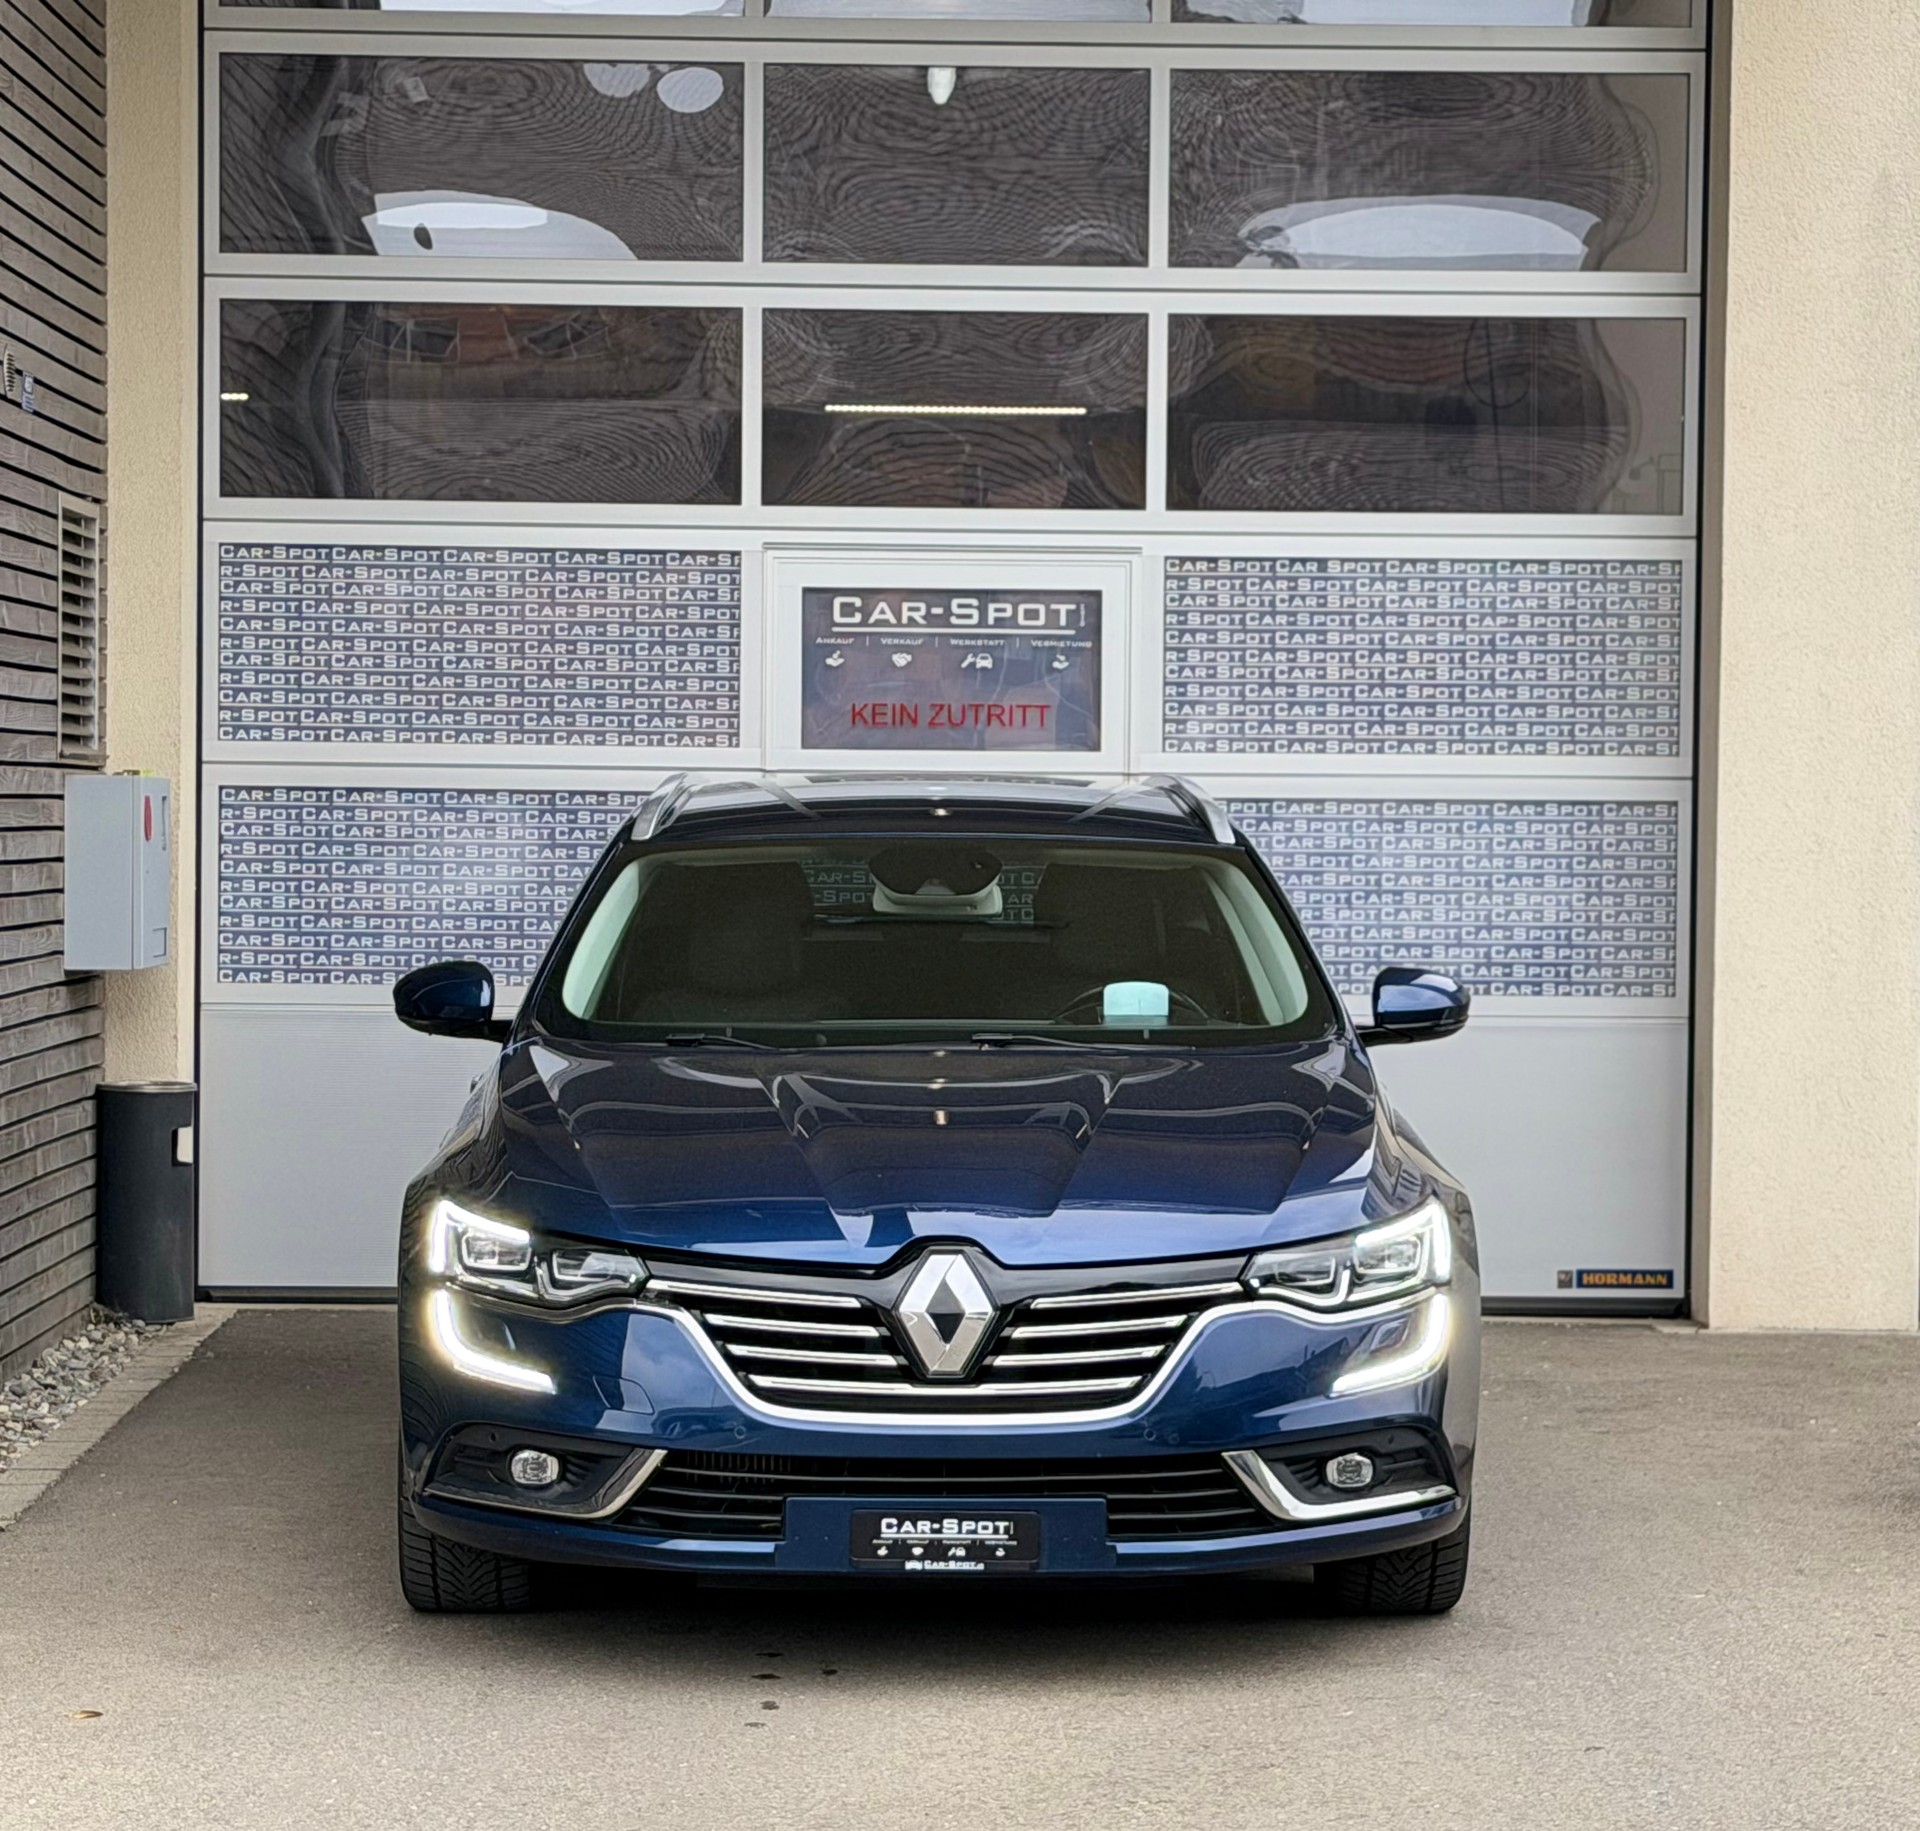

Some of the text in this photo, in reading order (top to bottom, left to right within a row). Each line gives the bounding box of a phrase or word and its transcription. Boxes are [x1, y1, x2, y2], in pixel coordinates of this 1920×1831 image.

[220, 545, 664, 565] CAR-SPOT CAR-SPOT CAR-SPOT CAR-SPOT
[302, 565, 411, 580] CAR-SPOT
[413, 567, 523, 581] CAR-SPOT
[525, 568, 634, 583] CAR-SPOT
[1166, 560, 1274, 573] CAR-SPOT
[1386, 561, 1494, 575] CAR-SPOT
[1496, 562, 1604, 575] CAR-SPOT
[220, 580, 663, 600] CAR-SPOT CAR-SPOT CAR-SPOT CAR-SPOT
[1246, 578, 1354, 591] CAR-SPOT
[1356, 579, 1464, 592] CAR-SPOT
[1466, 579, 1574, 593] CAR-SPOT
[302, 600, 411, 615] CAR-SPOT
[413, 602, 523, 616] CAR-SPOT
[524, 603, 634, 618] CAR-SPOT
[1166, 594, 1604, 610] CAR-SPOT CAR-SPOT CAR-SPOT CAR-SPOT
[832, 596, 1077, 626] CAR-SPOT
[220, 618, 663, 637] CAR-SPOT CAR-SPOT CAR-SPOT CAR-SPOT
[1246, 613, 1353, 626] CAR-SPOT
[1356, 614, 1463, 627] CAR-SPOT
[301, 637, 411, 652] CAR-SPOT
[413, 639, 522, 653] CAR-SPOT
[524, 641, 634, 655] CAR-SPOT
[1165, 631, 1603, 647] CAR-SPOT CAR-SPOT CAR-SPOT CAR-SPOT
[219, 653, 663, 672] CAR-SPOT CAR-SPOT CAR-SPOT CAR-SPOT
[1245, 650, 1353, 663] CAR-SPOT
[1356, 650, 1463, 664] CAR-SPOT
[1466, 651, 1573, 665] CAR-SPOT
[301, 672, 411, 687] CAR-SPOT
[412, 674, 522, 688] CAR-SPOT
[524, 675, 633, 690] CAR-SPOT
[1165, 665, 1603, 681] CAR-SPOT CAR-SPOT CAR-SPOT CAR-SPOT
[219, 690, 663, 709] CAR-SPOT CAR-SPOT CAR-SPOT CAR-SPOT
[1245, 685, 1353, 698] CAR-SPOT
[1355, 685, 1463, 699] CAR-SPOT
[1465, 686, 1573, 700] CAR-SPOT
[301, 710, 410, 724] CAR-SPOT
[412, 711, 522, 726] CAR-SPOT
[524, 713, 633, 728] CAR-SPOT
[851, 703, 1051, 729] KEIN ZUTRITT
[1165, 703, 1603, 719] CAR-SPOT CAR-SPOT CAR-SPOT CAR-SPOT
[219, 727, 662, 747] CAR-SPOT CAR-SPOT CAR-SPOT CAR-SPOT
[1245, 722, 1352, 735] CAR-SPOT
[1355, 722, 1462, 736] CAR-SPOT
[1465, 723, 1572, 737] CAR-SPOT
[1164, 740, 1602, 756] CAR-SPOT CAR-SPOT CAR-SPOT CAR-SPOT
[221, 789, 553, 806] CAR-SPOT CAR-SPOT CAR-SPOT
[302, 807, 523, 823] CAR-SPOT CAR-SPOT
[221, 823, 553, 840] CAR-SPOT CAR-SPOT CAR-SPOT
[302, 843, 522, 859] CAR-SPOT CAR-SPOT
[220, 860, 552, 877] CAR-SPOT CAR-SPOT CAR-SPOT
[301, 881, 522, 896] CAR-SPOT CAR-SPOT
[220, 895, 552, 912] CAR-SPOT CAR-SPOT CAR-SPOT
[301, 915, 522, 931] CAR-SPOT CAR-SPOT
[219, 933, 551, 950] CAR-SPOT CAR-SPOT CAR-SPOT
[300, 952, 410, 967] CAR-SPOT
[219, 970, 328, 984] CAR-SPOT
[881, 1518, 1009, 1534] CAR-SPOT
